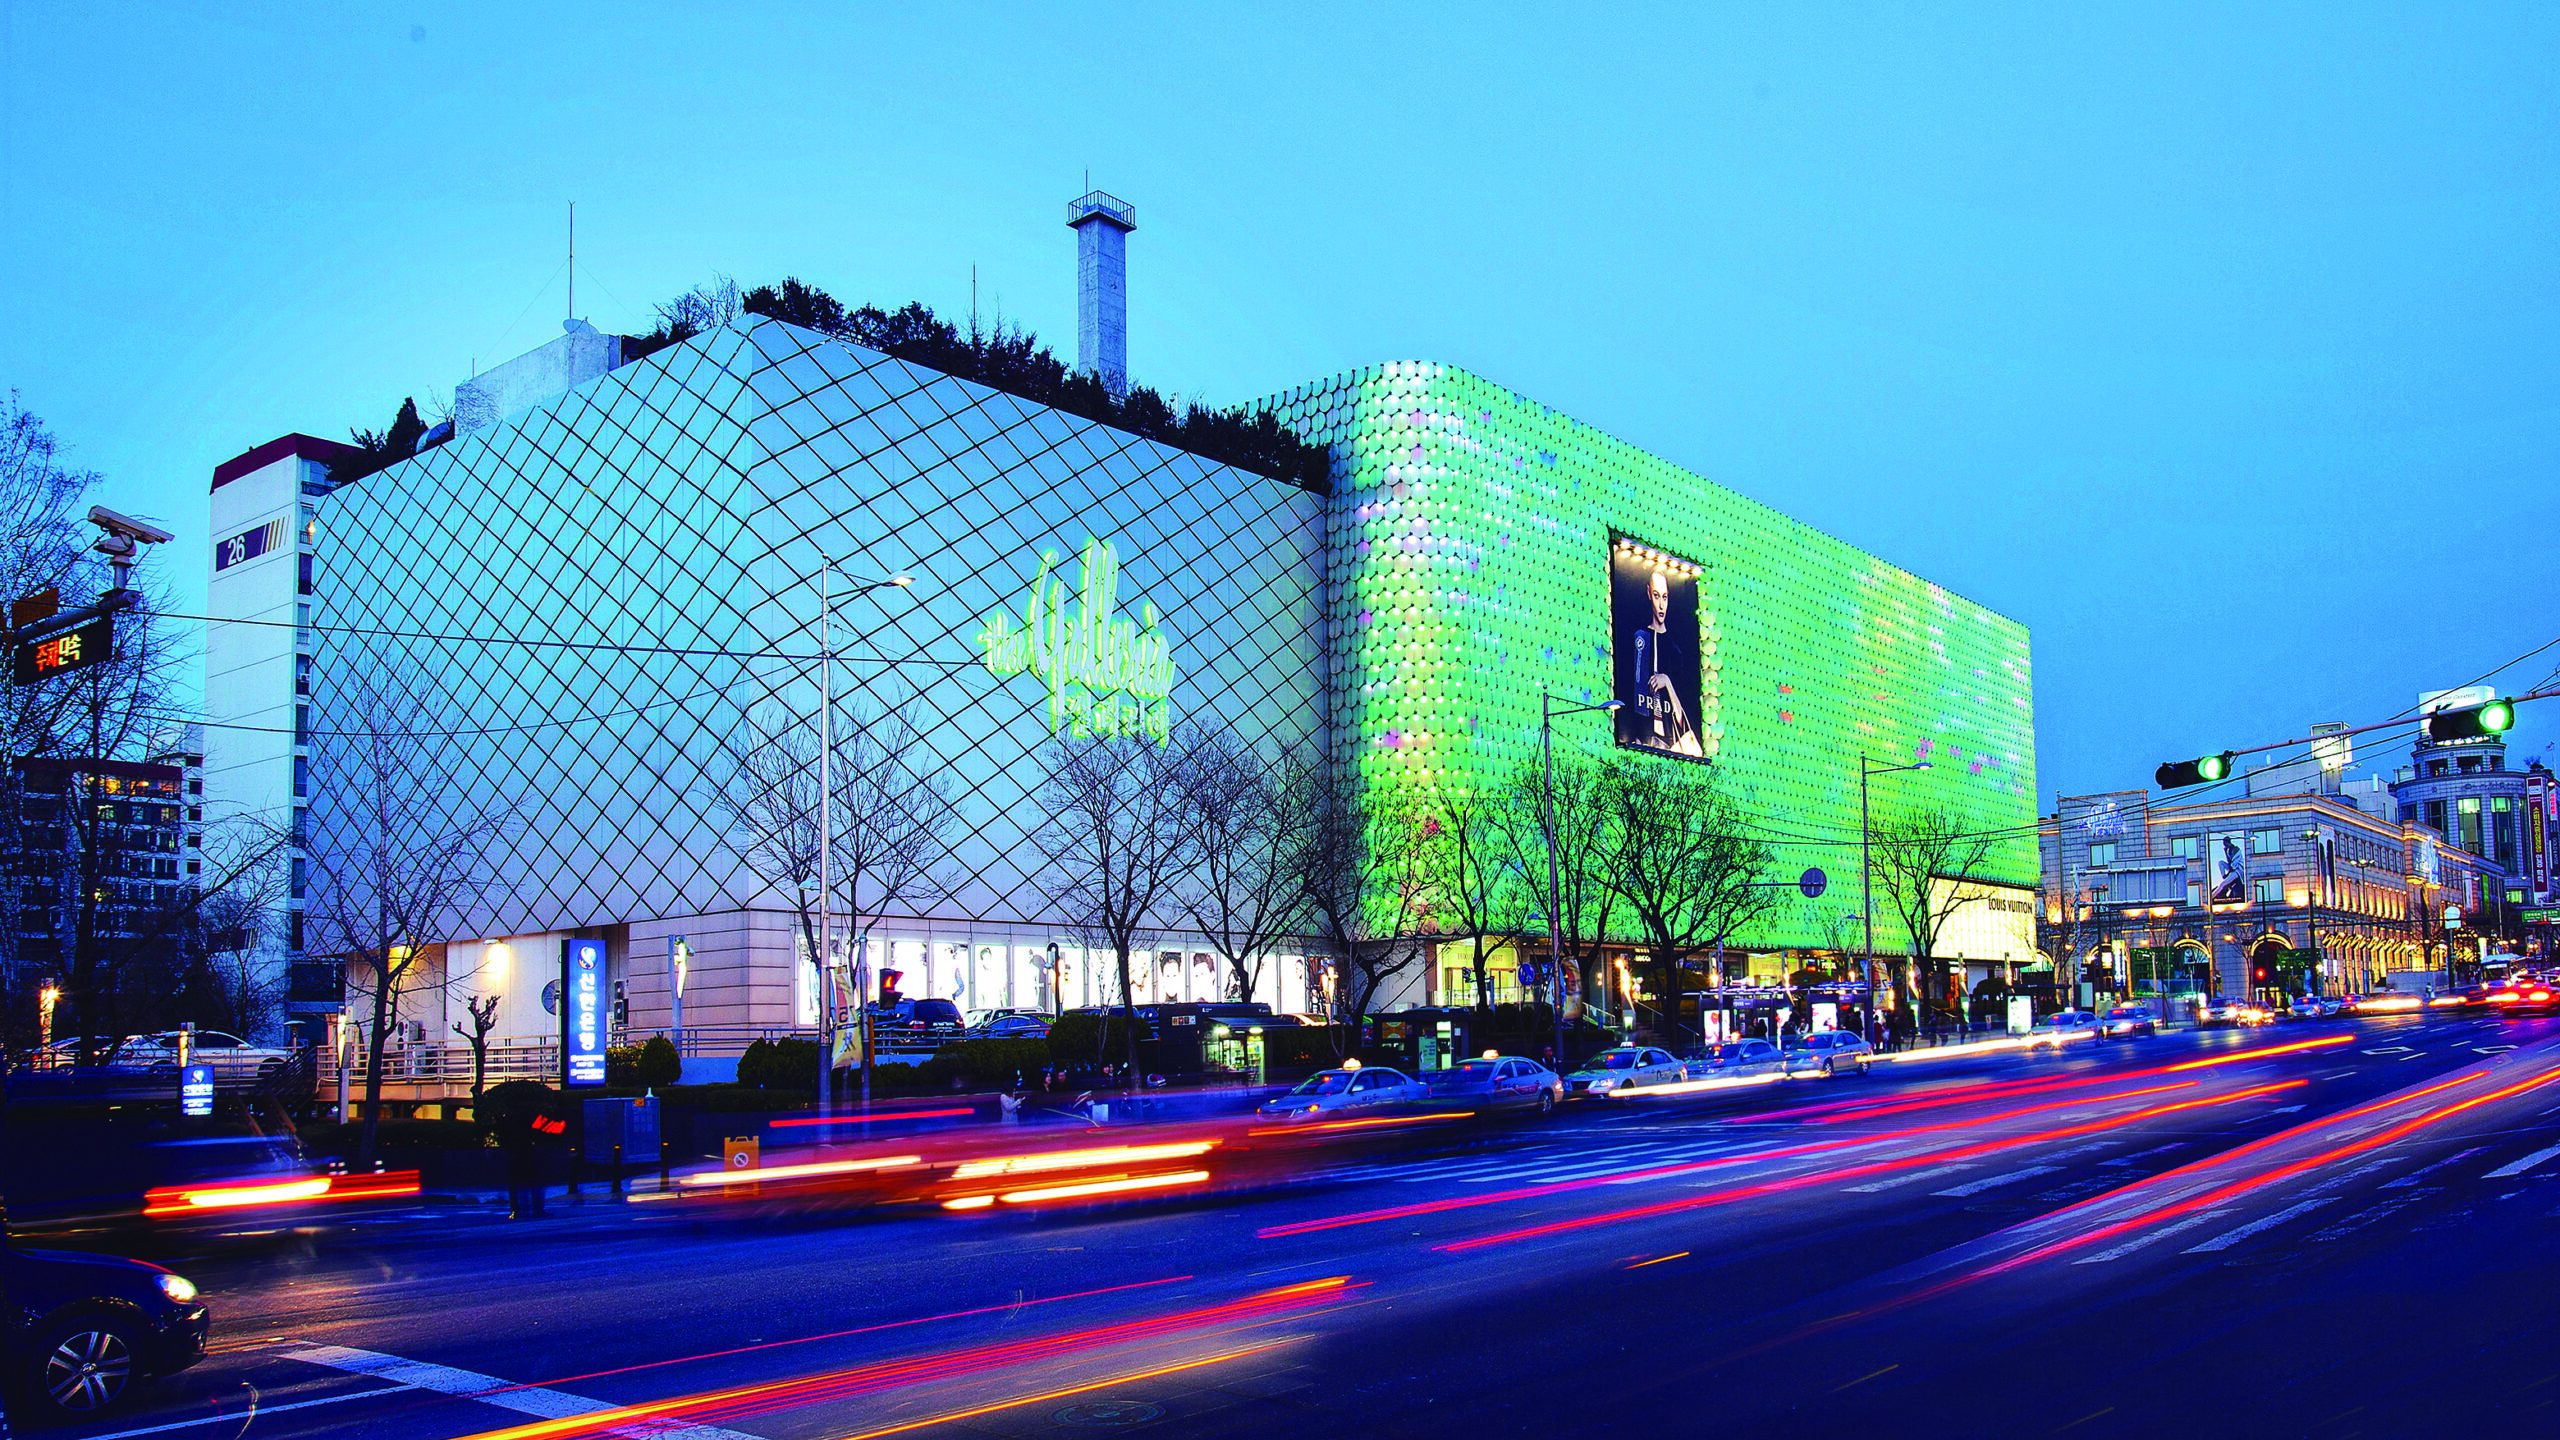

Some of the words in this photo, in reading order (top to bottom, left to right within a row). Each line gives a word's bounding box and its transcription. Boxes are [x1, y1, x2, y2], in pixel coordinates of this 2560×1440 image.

[228, 535, 246, 566] 26
[977, 611, 1031, 673] the
[1638, 694, 1671, 714] PRAD
[1988, 898, 2006, 911] LOUIS
[2007, 900, 2033, 914] VUITTON
